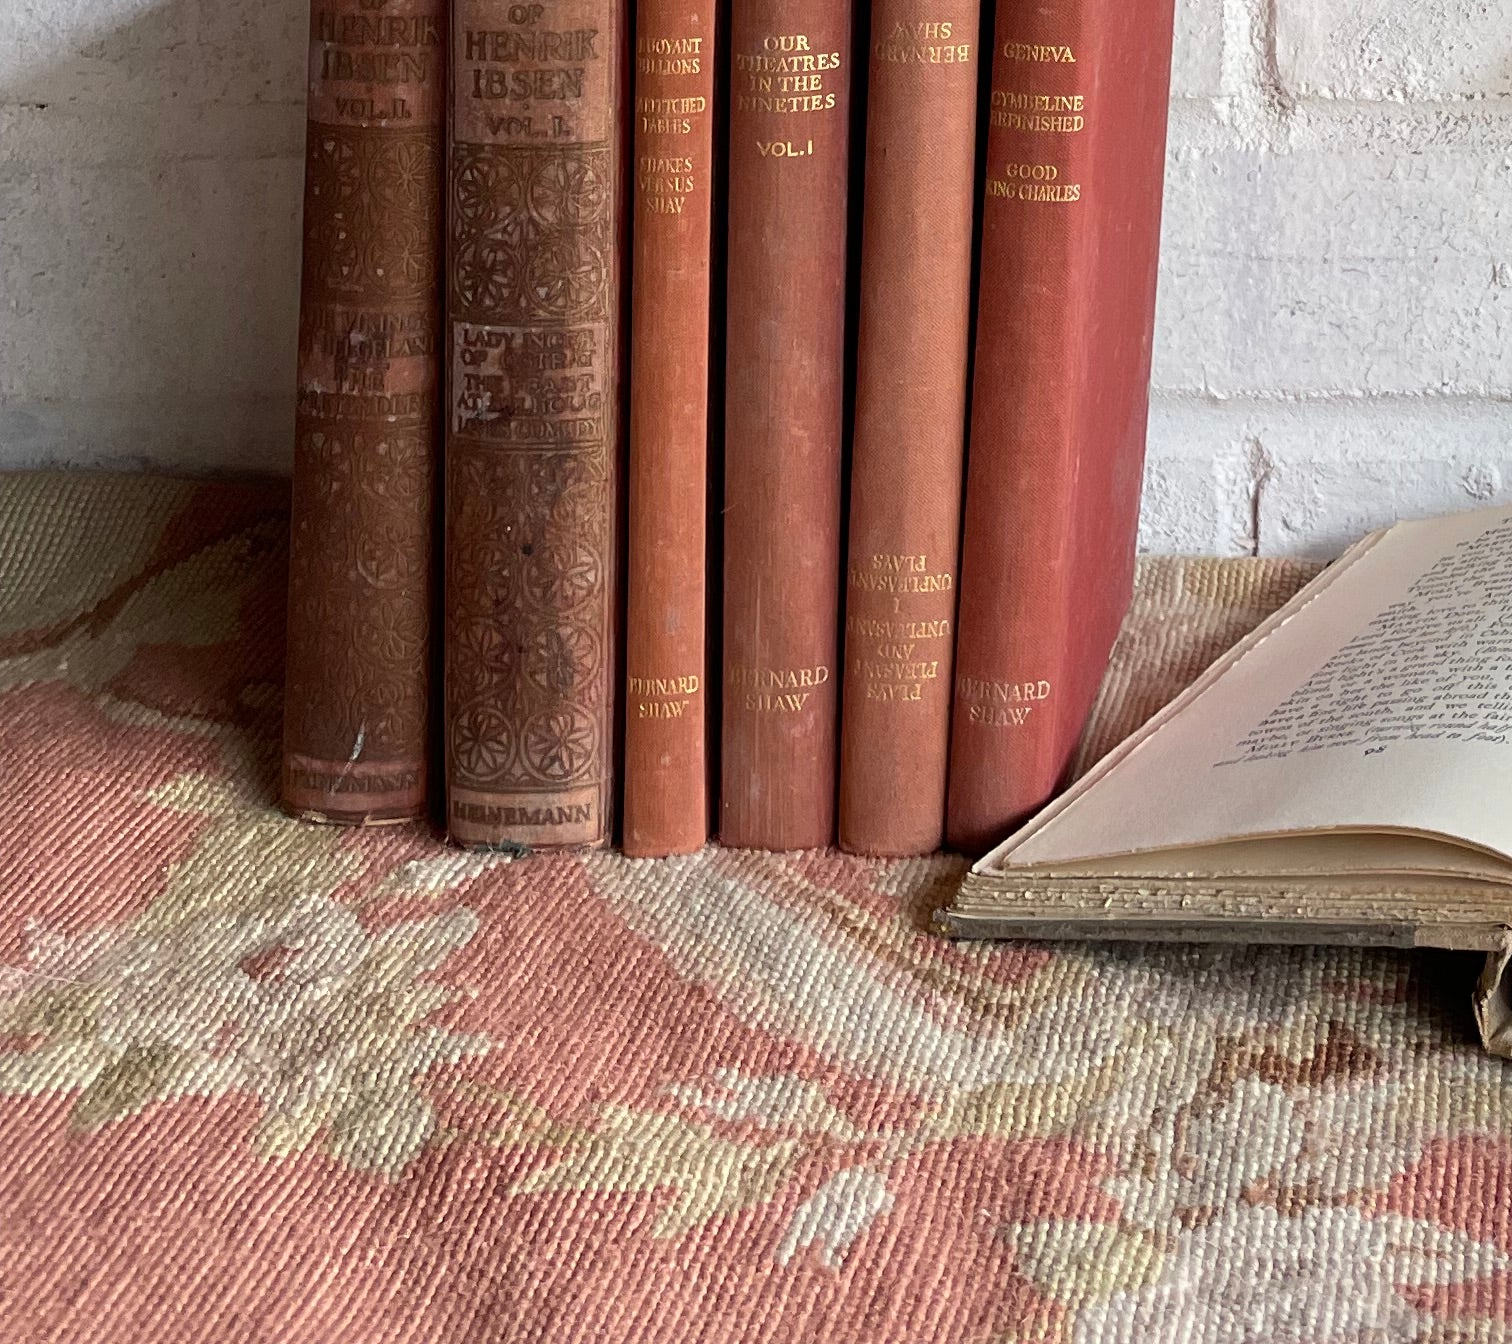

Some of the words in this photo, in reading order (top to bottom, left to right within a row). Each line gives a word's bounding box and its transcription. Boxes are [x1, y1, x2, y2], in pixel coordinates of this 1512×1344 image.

[508, 4, 545, 26] OF
[465, 28, 600, 63] HENRIK
[764, 34, 811, 52] OUR
[1003, 42, 1077, 63] GENEVA
[737, 52, 841, 72] THEATRES
[472, 67, 585, 100] IBSEN
[750, 75, 772, 93] IN
[778, 74, 823, 93] THE
[739, 93, 836, 113] NINETIES
[992, 90, 1084, 113] CYMBELINE
[1006, 165, 1058, 182] GOOD
[1018, 183, 1082, 203] CHARLES
[872, 554, 927, 573] PLAYS
[629, 675, 699, 696] BERNARD
[730, 665, 830, 690] BERNARD
[959, 677, 1052, 704] BERNARD
[1431, 690, 1490, 702] abroad
[639, 699, 690, 719] SHAW
[745, 691, 810, 713] SHAW
[1403, 701, 1437, 713] and
[1444, 701, 1469, 711] we
[968, 705, 1034, 727] SHAW
[454, 799, 592, 826] HEINEMANN
